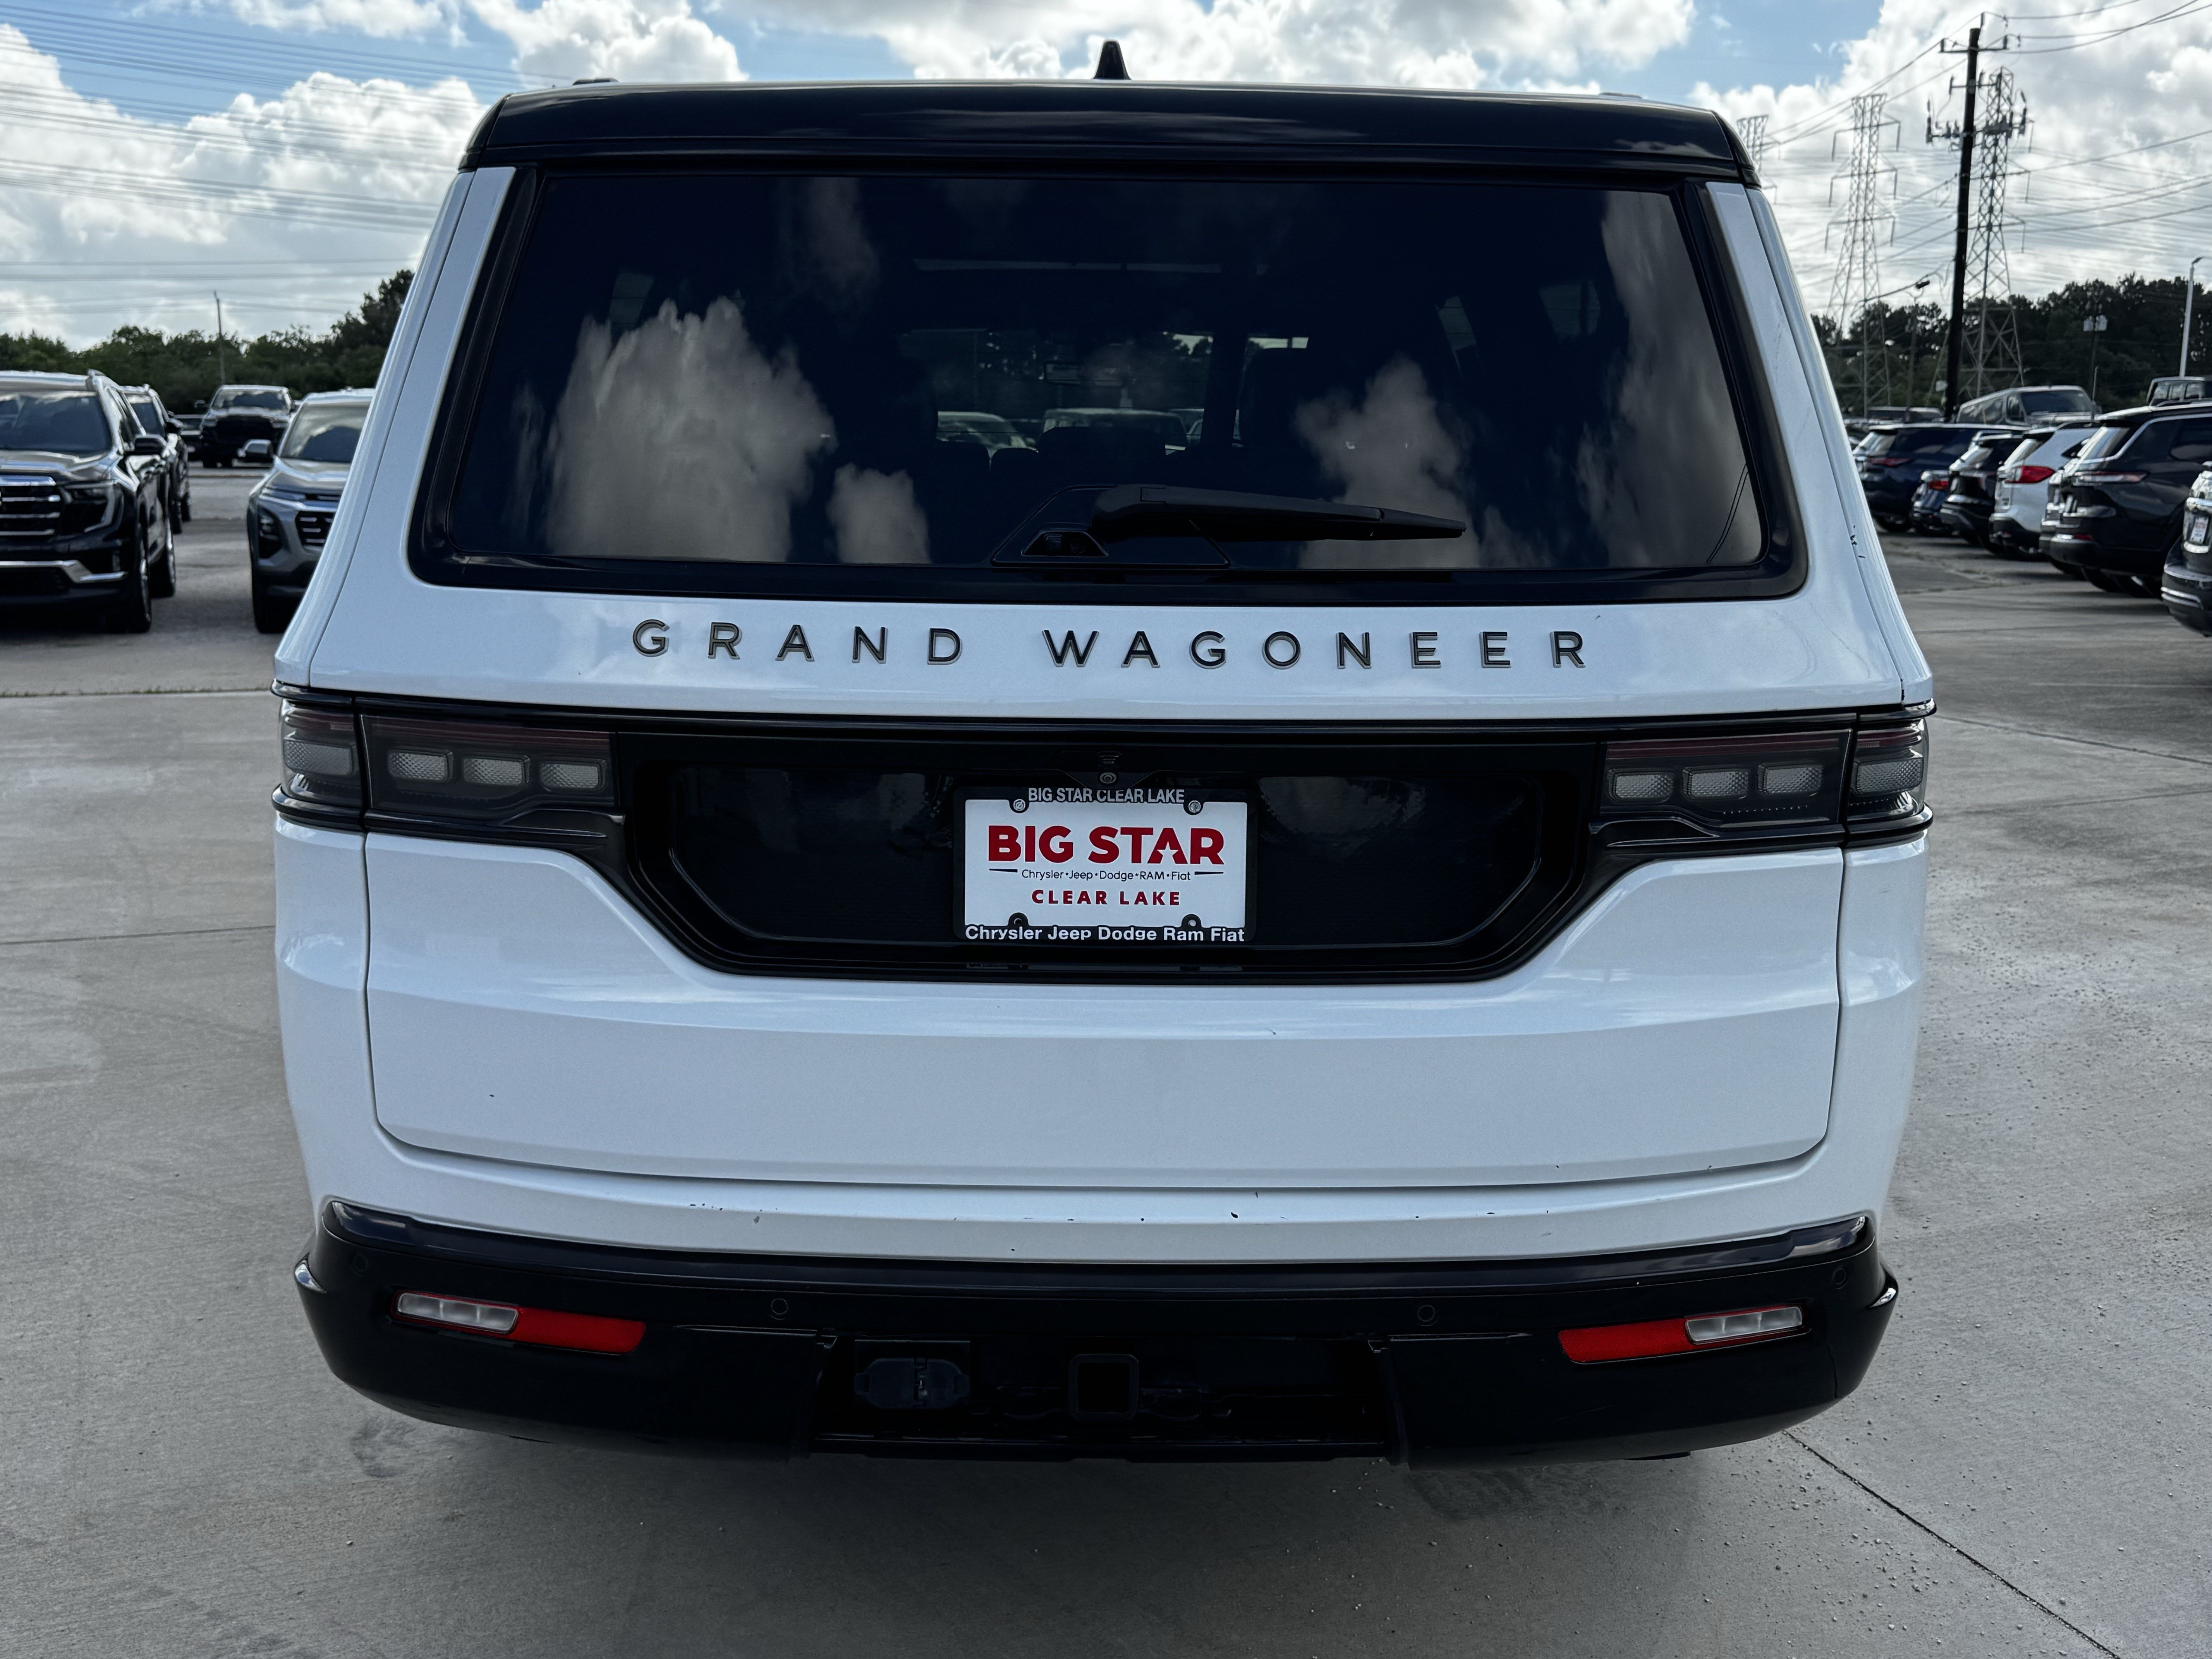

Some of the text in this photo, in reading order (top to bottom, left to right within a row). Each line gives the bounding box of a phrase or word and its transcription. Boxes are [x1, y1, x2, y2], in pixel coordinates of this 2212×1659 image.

[632, 618, 1587, 670] GRAND WAGONEER
[1029, 788, 1185, 803] BIG STAR CLEAR LAKE
[989, 825, 1224, 864] BIG STAR
[1032, 890, 1180, 906] CLEAR LAKE
[965, 926, 1245, 942] Chrysler Jeep Dodge Ram Fiat
